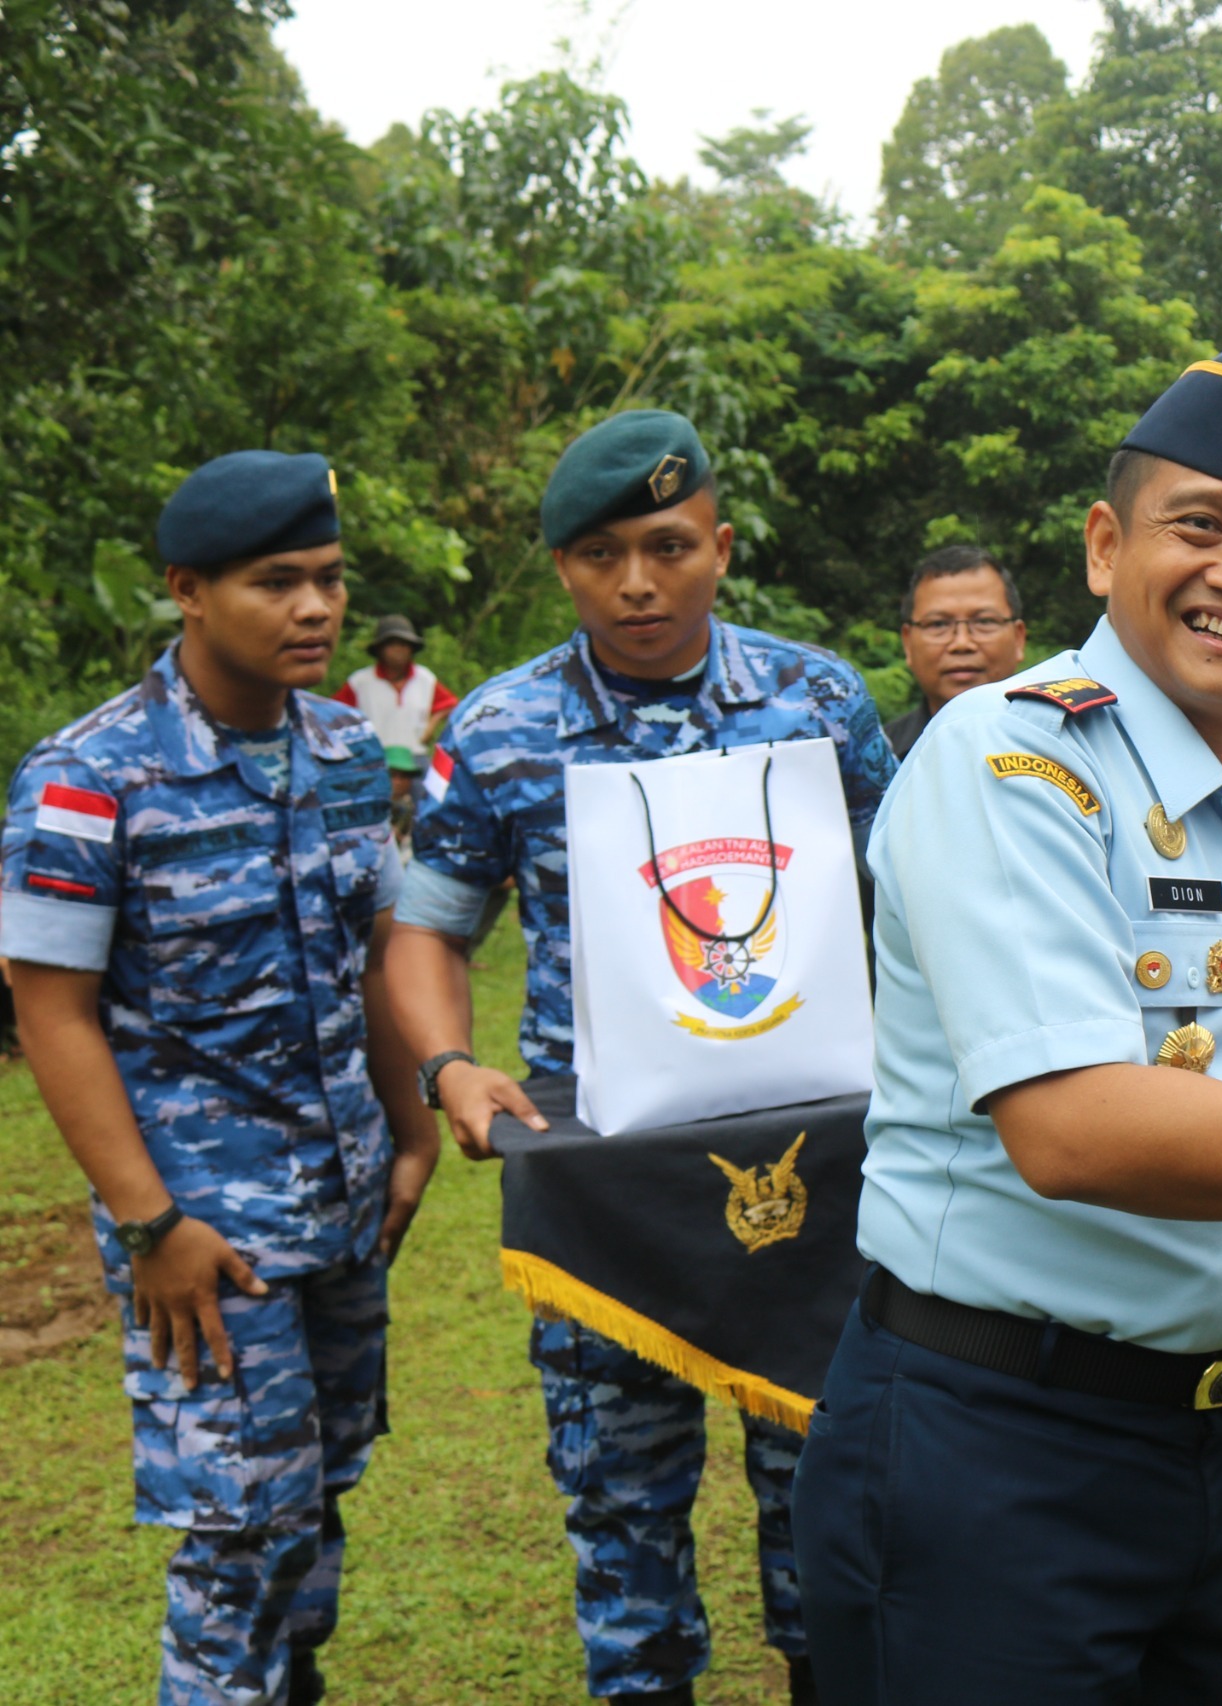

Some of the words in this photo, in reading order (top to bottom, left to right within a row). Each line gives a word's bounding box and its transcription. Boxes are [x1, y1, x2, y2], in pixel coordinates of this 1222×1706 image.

[998, 756, 1089, 806] INDONESIA
[725, 839, 747, 850] TNI
[749, 841, 769, 852] AU
[1171, 886, 1204, 902] DION
